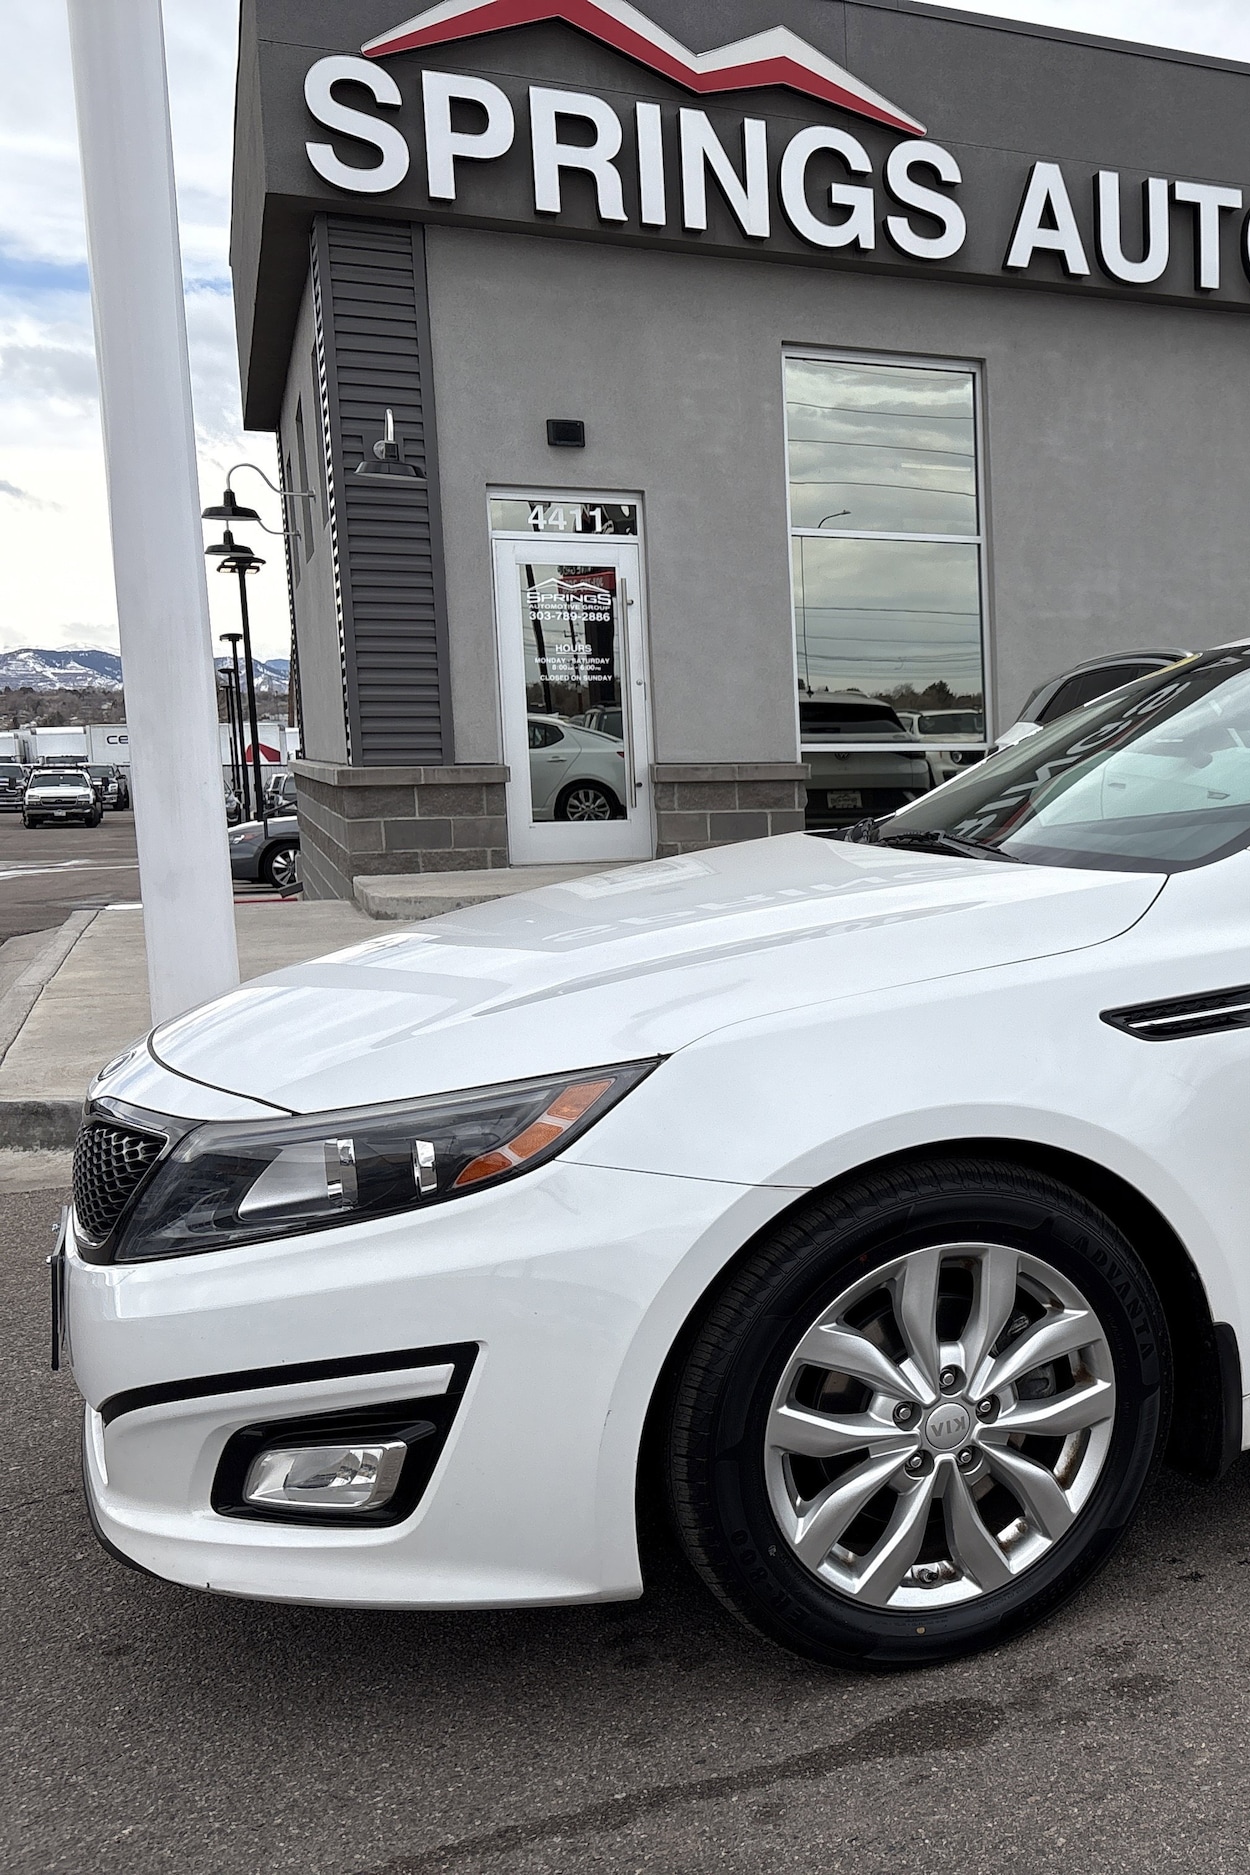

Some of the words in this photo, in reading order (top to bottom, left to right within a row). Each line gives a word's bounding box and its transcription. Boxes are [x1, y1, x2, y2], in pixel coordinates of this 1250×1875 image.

[303, 54, 967, 260] SPRINGS
[527, 504, 602, 532] 4411
[526, 591, 611, 605] SPRINGS
[529, 611, 610, 621] 303-789-2886
[555, 643, 592, 654] HOURS
[571, 657, 610, 665] SATURDAY
[539, 674, 570, 682] CLOSED
[571, 674, 582, 682] ON
[583, 674, 613, 682] SUNDAY
[1070, 1234, 1156, 1361] ADVANTA
[930, 1415, 966, 1437] KIA
